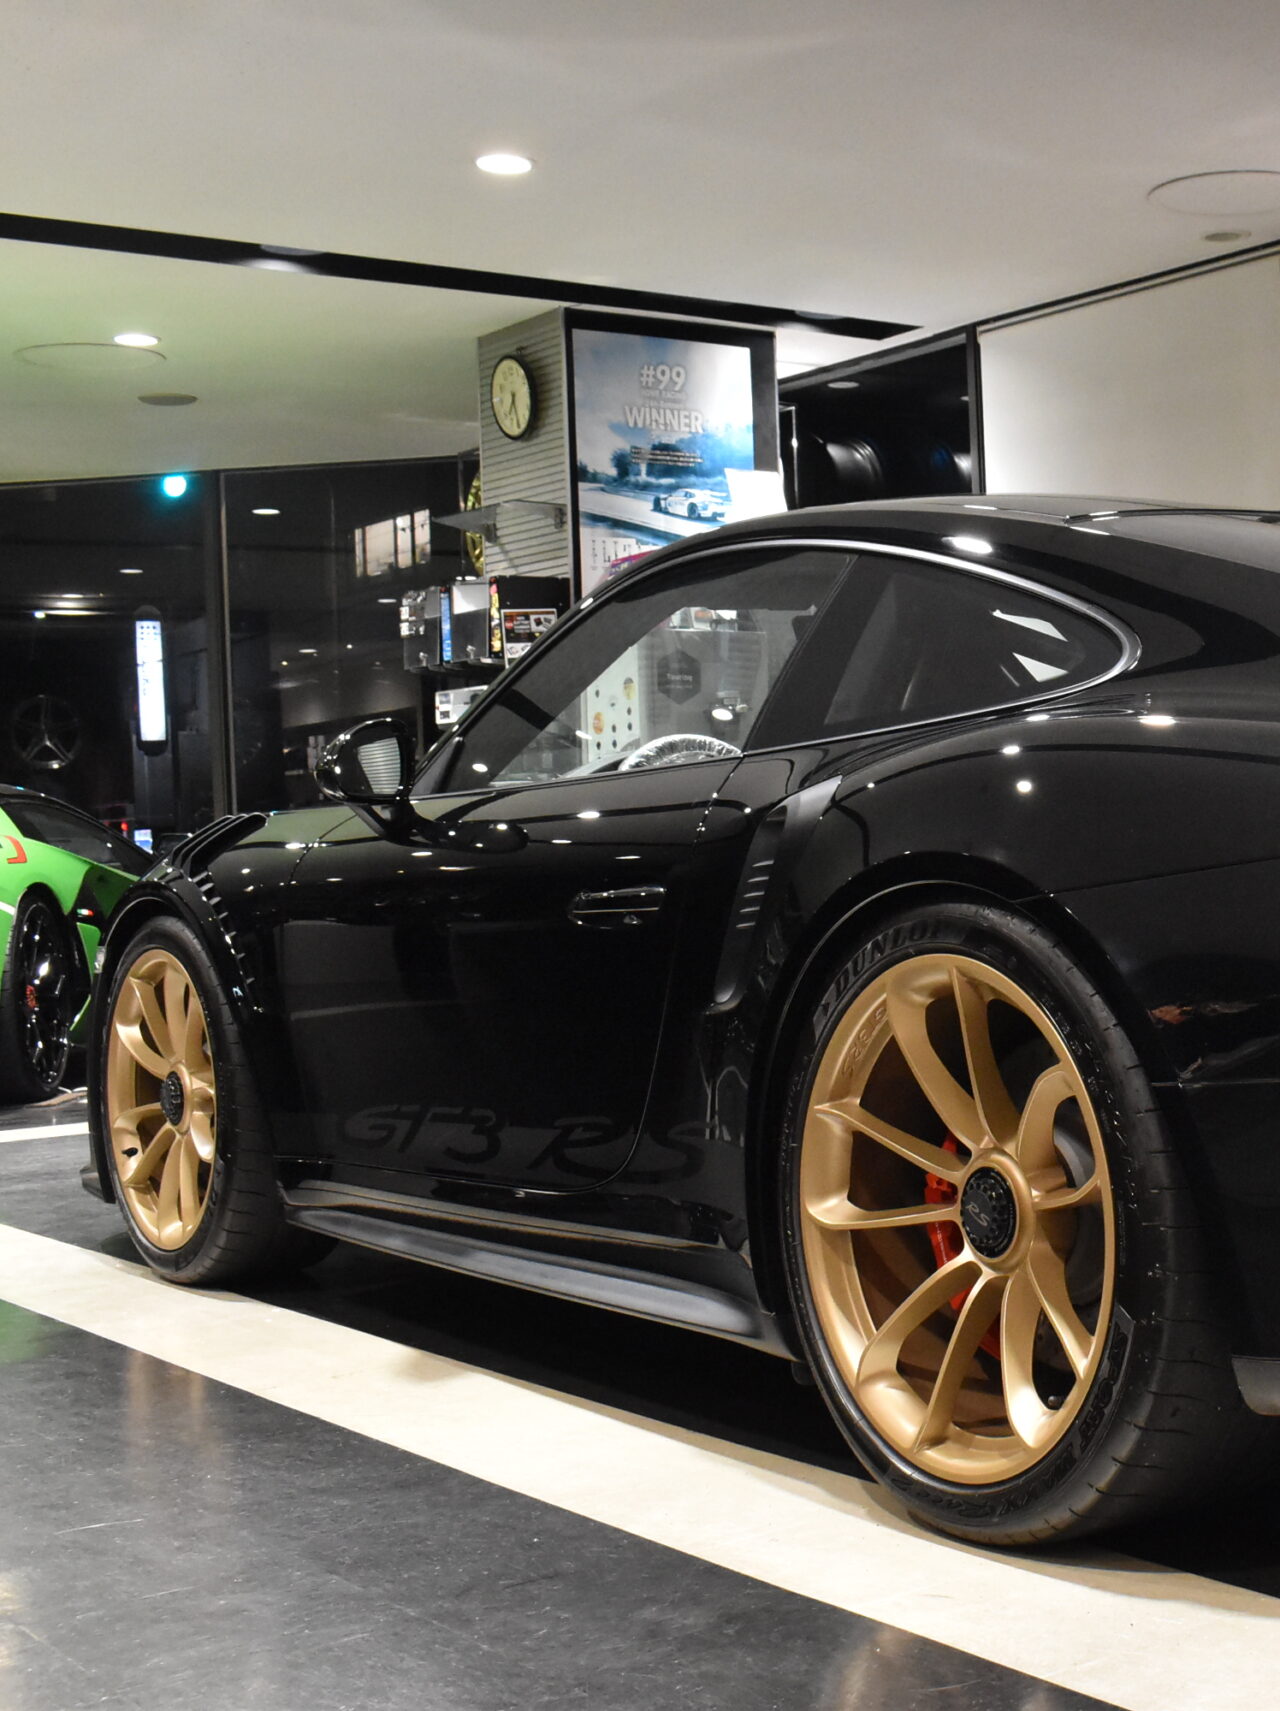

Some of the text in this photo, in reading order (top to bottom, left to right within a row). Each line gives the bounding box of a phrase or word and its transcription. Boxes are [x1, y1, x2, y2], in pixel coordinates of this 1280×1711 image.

[640, 364, 686, 391] #99
[624, 405, 704, 433] WINNER
[834, 918, 946, 1001] DUNLOP
[343, 1104, 713, 1185] GT3 RS
[965, 1202, 990, 1227] RS
